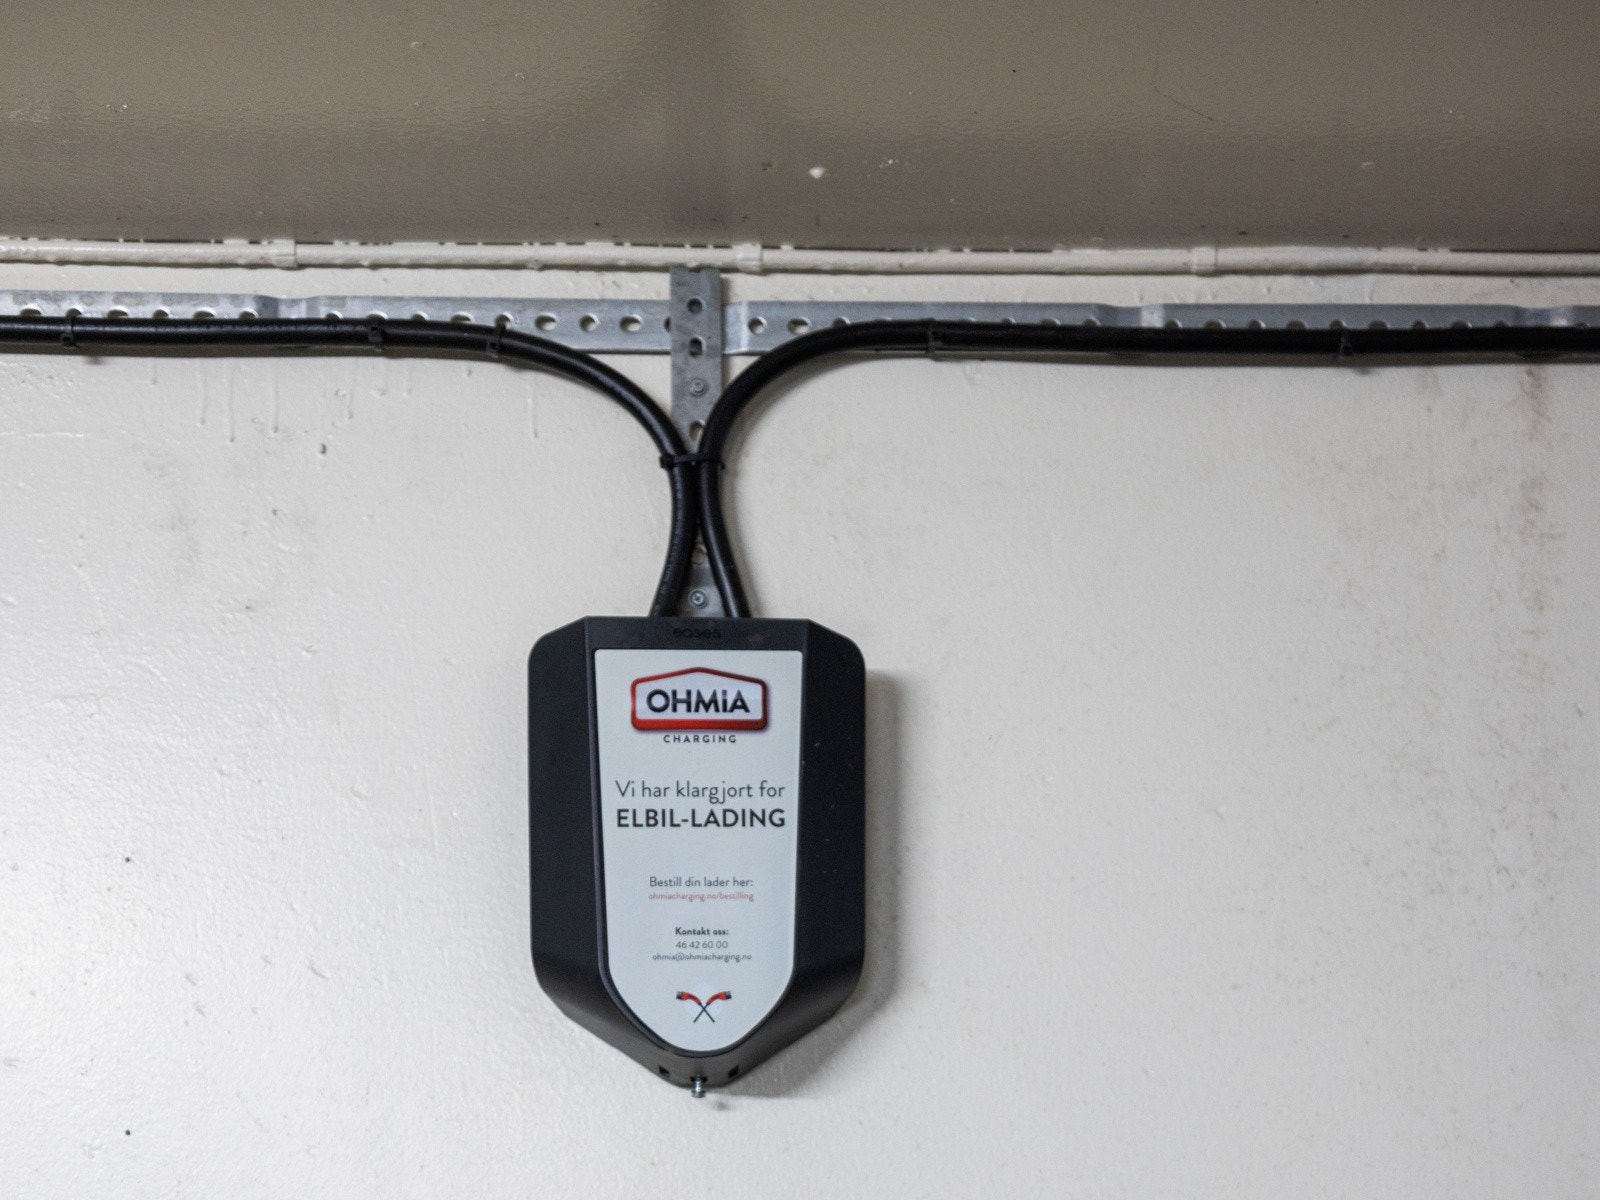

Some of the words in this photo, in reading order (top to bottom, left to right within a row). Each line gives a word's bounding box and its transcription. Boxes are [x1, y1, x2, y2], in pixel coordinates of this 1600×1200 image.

[663, 734, 737, 744] CHARGING
[615, 780, 635, 798] Vi
[641, 780, 670, 798] har
[676, 780, 753, 804] klargjort
[759, 780, 786, 798] for
[616, 808, 786, 828] ELBIL-LADING
[649, 876, 682, 887] Bestill
[684, 876, 701, 887] din
[704, 876, 730, 887] lader
[732, 876, 754, 887] her:
[675, 926, 710, 936] Kontakt
[712, 928, 729, 936] oss:
[675, 940, 687, 949] 46
[688, 940, 700, 949] 42
[702, 940, 714, 949] 60
[715, 940, 728, 949] 00
[652, 952, 752, 963] ohmia@ohmiacharging.no
